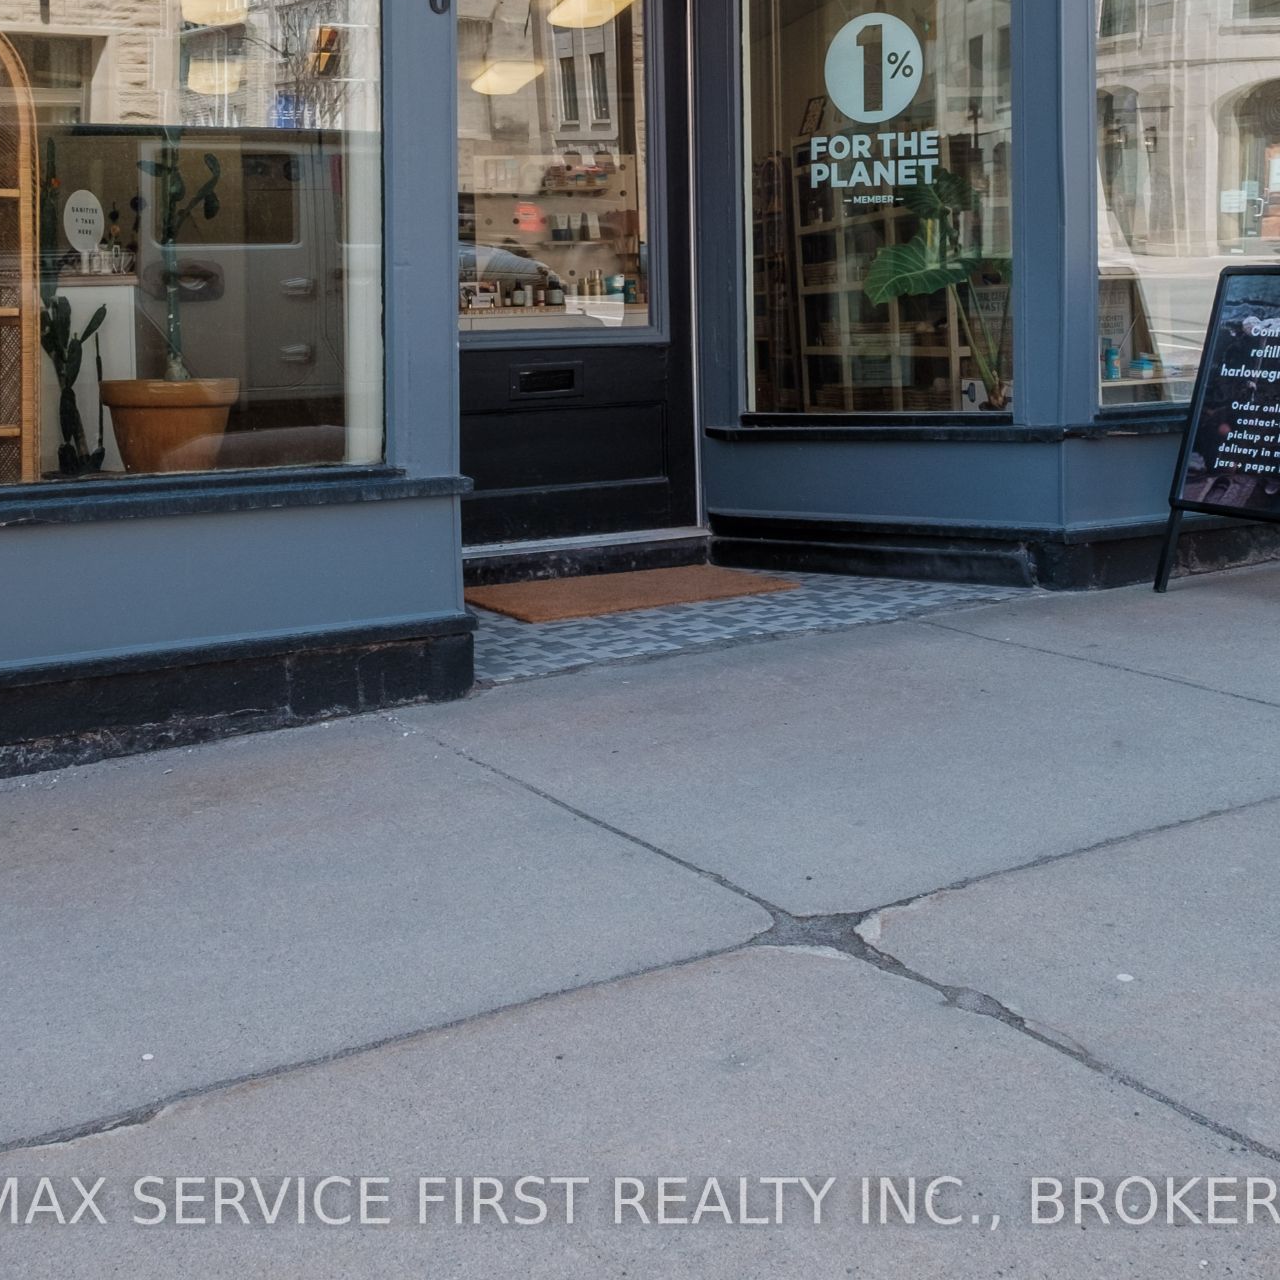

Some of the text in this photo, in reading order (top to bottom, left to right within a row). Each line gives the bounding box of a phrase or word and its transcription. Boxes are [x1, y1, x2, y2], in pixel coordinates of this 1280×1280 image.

[810, 130, 939, 161] FOR THE
[810, 158, 939, 188] PLANET
[853, 195, 894, 204] MEMBER
[1231, 401, 1260, 411] Order
[1227, 430, 1261, 443] pickup
[1218, 443, 1258, 458] delivery
[1261, 448, 1271, 456] in
[1214, 458, 1235, 468] jars
[1245, 463, 1276, 473] paper
